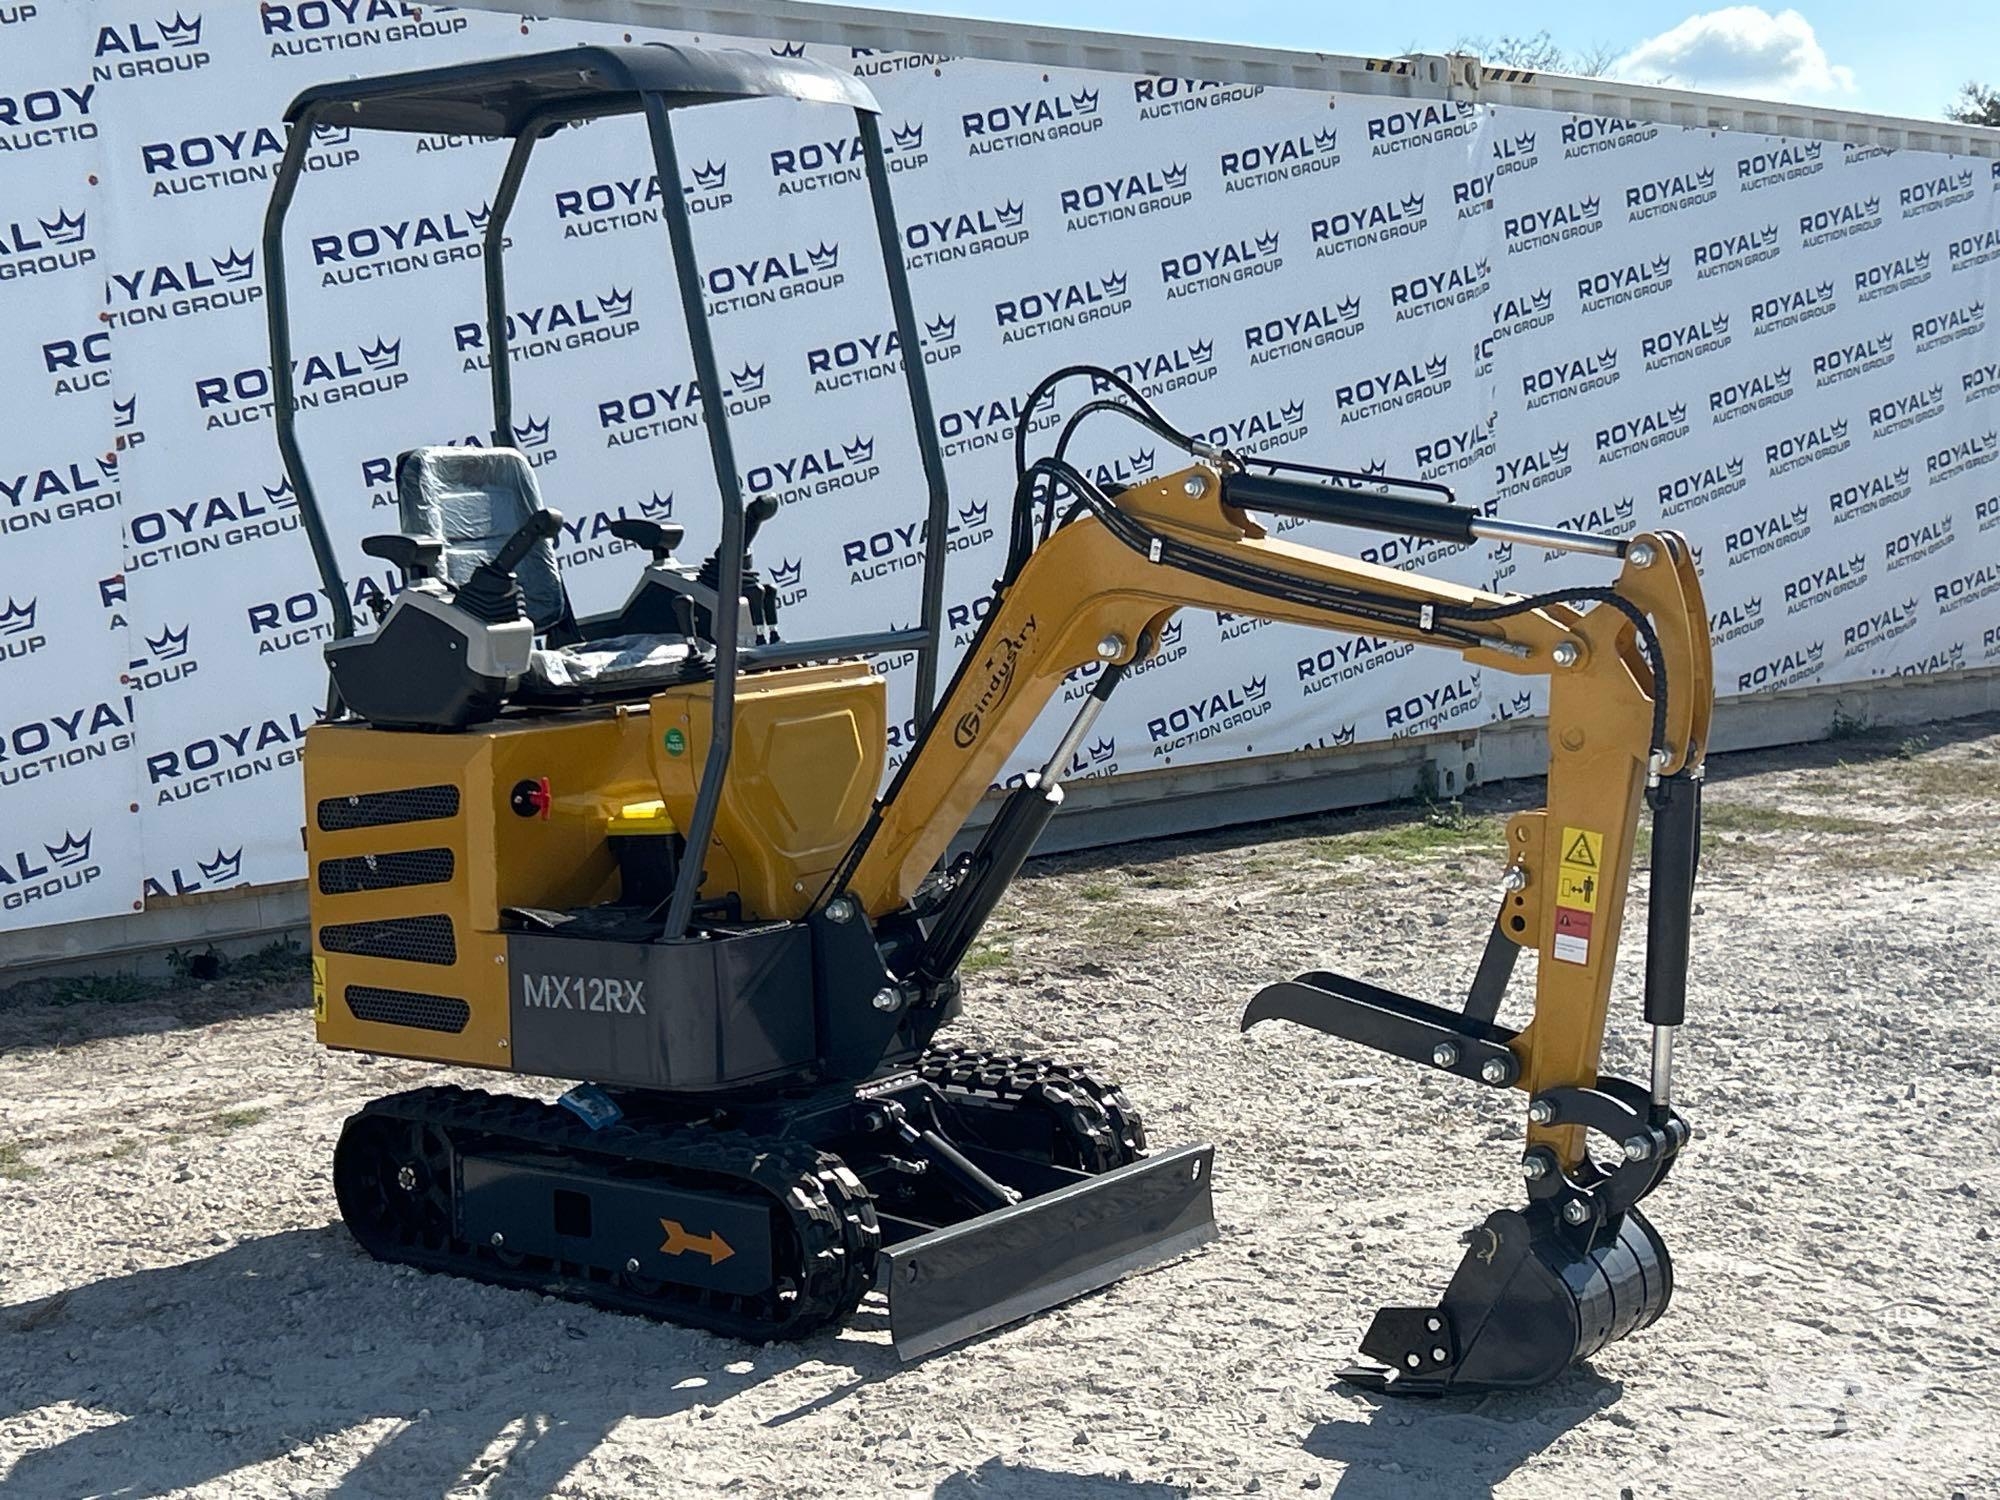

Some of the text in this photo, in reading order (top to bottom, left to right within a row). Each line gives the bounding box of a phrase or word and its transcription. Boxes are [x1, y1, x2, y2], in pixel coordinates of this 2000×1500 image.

[271, 18, 467, 58] AUCTION GROUP
[118, 53, 210, 78] GROUP
[854, 50, 935, 76] AUCTION
[962, 97, 1072, 138] ROYAL
[1140, 82, 1266, 120] AUCTION GROUP
[970, 118, 1103, 156] AUCTION GROUP
[1368, 99, 1458, 140] ROYAL
[142, 128, 286, 174] ROYA
[771, 132, 866, 176] ROYA
[1222, 137, 1314, 176] ROYAL
[1372, 132, 1432, 157] AUCTION
[1565, 129, 1658, 160] AUCTION GROUP
[1738, 146, 1804, 178] ROYAL
[153, 165, 268, 197] AUCTION
[778, 168, 861, 196] AUCTION
[1226, 156, 1340, 193] AUCTION GROUP
[1497, 157, 1538, 176] GROUP
[1061, 172, 1163, 214] ROYAL
[1626, 173, 1699, 208] ROYAL
[1900, 176, 1958, 206] ROYAL
[564, 209, 658, 239] AUCTION
[906, 210, 996, 249] OYAL
[1067, 192, 1192, 232] AUCTION GROUP
[1312, 202, 1402, 242] ROYAL
[1504, 204, 1581, 239] ROYAL
[1629, 201, 1678, 223] AUCTION
[1800, 202, 1867, 234] ROYAL
[312, 214, 469, 265] ROYAL
[970, 230, 1029, 254] GROUP
[1316, 219, 1427, 259] AUCTION GROUP
[1508, 220, 1602, 255] AUCTION GROUP
[1694, 232, 1761, 266] ROYAL
[0, 249, 96, 280] GROUP
[322, 254, 428, 287] AUCTION
[1161, 241, 1256, 282] ROYAL
[1167, 258, 1282, 300] AUCTION GROUP
[1855, 256, 1916, 290] ROYAL
[780, 274, 844, 299] GROUP
[1392, 264, 1479, 306] ROYAL
[1578, 264, 1652, 299] ROYAL
[1582, 279, 1672, 314] AUCTION GROUP
[172, 286, 262, 316] GROUP
[995, 281, 1102, 326] ROYAL
[1396, 296, 1454, 322] AUCTION
[1752, 289, 1817, 322] ROYAL
[566, 321, 640, 348] GROUP
[1003, 300, 1131, 344] AUCTION GROUP
[1245, 306, 1337, 349] ROYAL
[1514, 313, 1554, 334] GROUP
[1642, 322, 1712, 358] ROYAL
[1912, 307, 1972, 340] ROYAL
[808, 327, 902, 374] ROYA
[1250, 322, 1364, 366] AUCTION GROUP
[1814, 341, 1878, 374] ROYAL
[324, 373, 408, 404] GROUP
[815, 362, 896, 394] AUCTION
[1166, 366, 1217, 391] GROUP
[1336, 366, 1425, 408] ROYAL
[1523, 357, 1594, 395] ROYAL
[1527, 372, 1620, 410] AUCTION GROUP
[1710, 375, 1774, 411] ROYAL
[598, 375, 706, 428] ROYA
[1341, 380, 1451, 425] AUCTION GROUP
[1869, 392, 1930, 426] ROYAL
[608, 413, 698, 448] AUCTION
[1260, 426, 1308, 451] GROUP
[1596, 412, 1668, 450] ROYAL
[1766, 425, 1833, 464] ROYAL
[1599, 440, 1648, 464] AUCTION
[1927, 436, 1984, 472] ROYAL
[816, 466, 880, 494] GROUP
[1525, 466, 1572, 490] GROUP
[1658, 463, 1729, 504] ROYAL
[1830, 473, 1896, 511] ROYAL
[1726, 512, 1794, 553] ROYAL
[1886, 524, 1941, 558] ROYAL
[851, 548, 929, 585] AUCTION
[1784, 560, 1851, 602] ROYAL
[1934, 567, 1996, 602] ROYAL
[1844, 604, 1906, 646] ROYAL
[1134, 646, 1187, 675] GROUP
[1304, 641, 1416, 696] AUCTION GROUP
[1739, 651, 1806, 691] ROYAL
[1148, 690, 1244, 742] ROYAL
[1386, 692, 1473, 728] ROYAL
[1154, 701, 1271, 757] AUCTION GROUP
[158, 757, 272, 806] AUCTION
[3, 866, 100, 910] GROUP
[523, 974, 646, 1015] MX12RX
